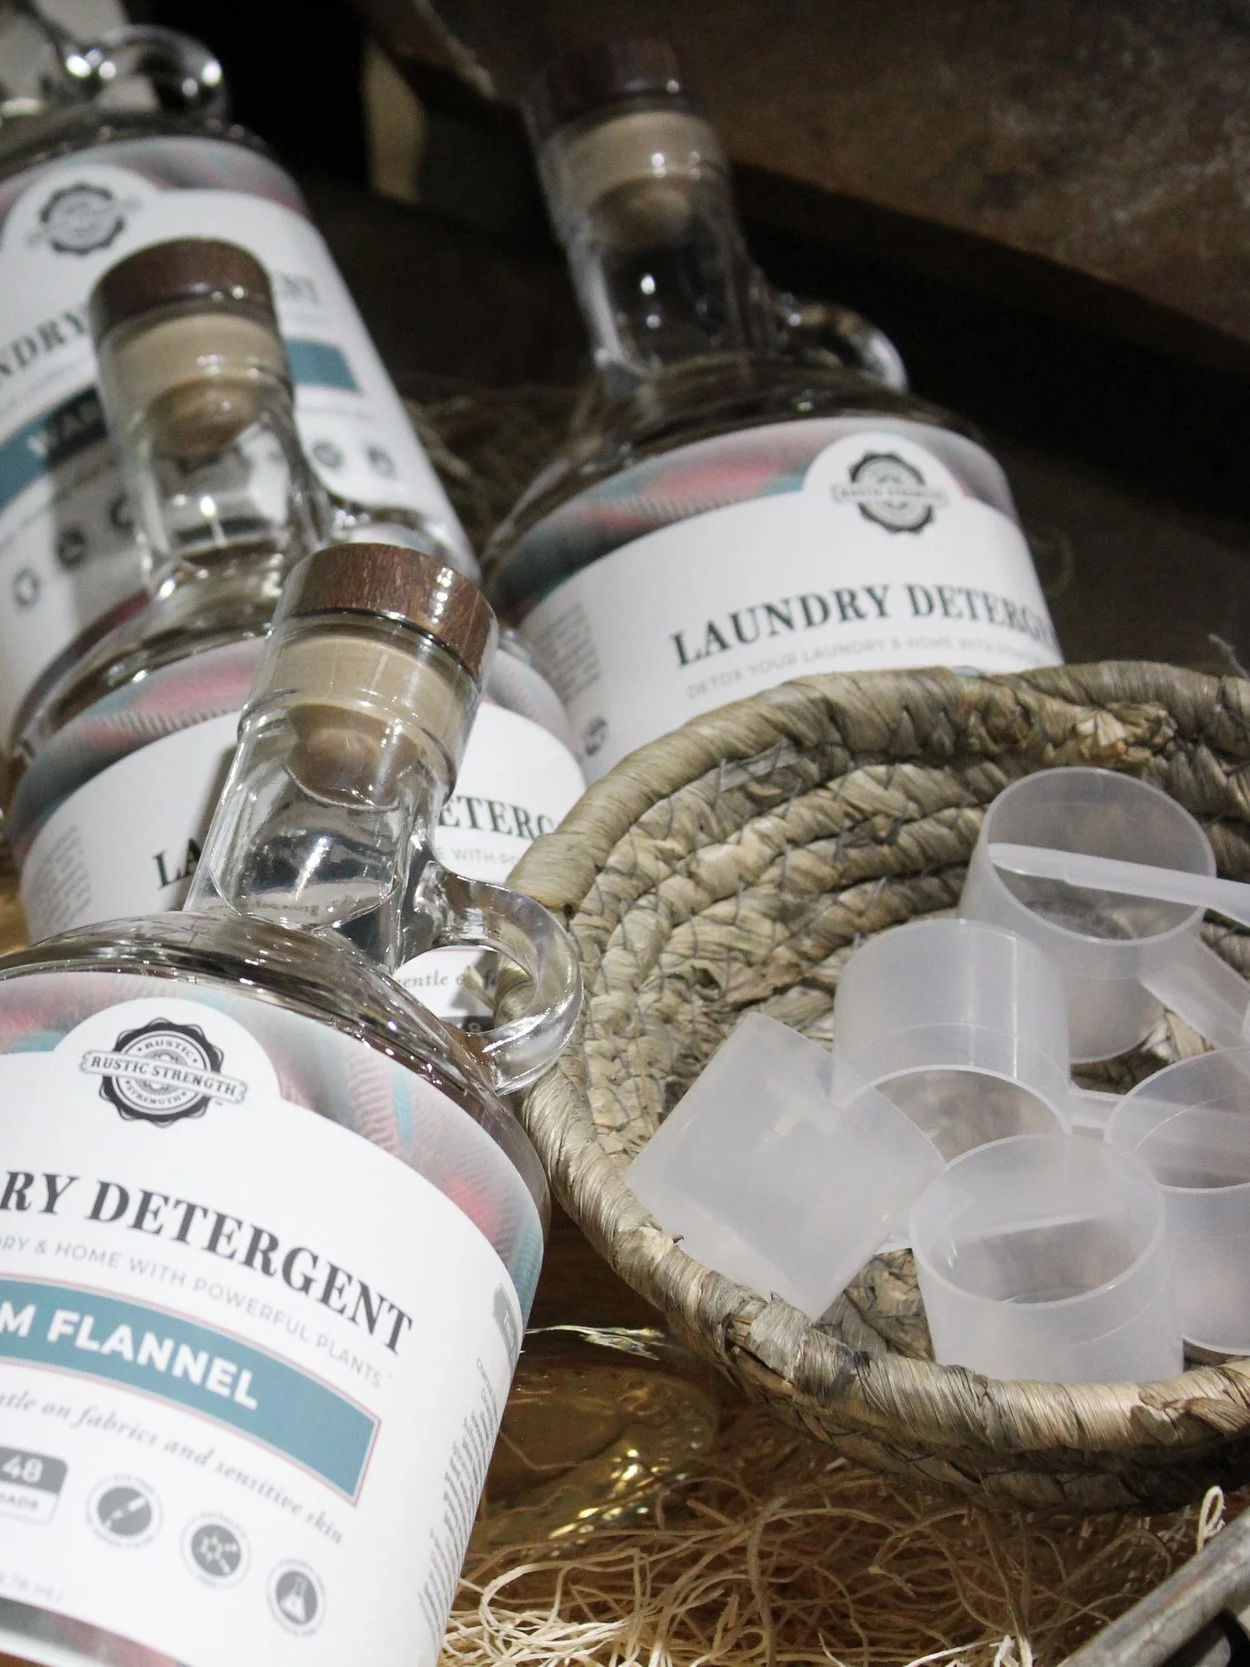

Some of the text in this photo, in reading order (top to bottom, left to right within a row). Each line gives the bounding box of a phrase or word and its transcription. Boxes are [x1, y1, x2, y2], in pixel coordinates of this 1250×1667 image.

[670, 585, 891, 669] LAUNDRY
[902, 583, 1051, 646] DETERG
[91, 1055, 237, 1096] RUSTIC STRENGTH
[144, 1038, 195, 1059] RUSTIC
[34, 1241, 48, 1256] &
[54, 1241, 122, 1269] HOME
[130, 1256, 187, 1287] WITH
[193, 1276, 309, 1343] POWERFUL
[84, 1179, 414, 1356] DETERGENT
[46, 1308, 258, 1411] FLANNEL
[0, 1455, 43, 1484] 48
[41, 1399, 71, 1420] on
[70, 1404, 159, 1447] fabrics
[162, 1439, 215, 1467] and
[215, 1460, 303, 1516] sensitive
[306, 1508, 344, 1546] skin
